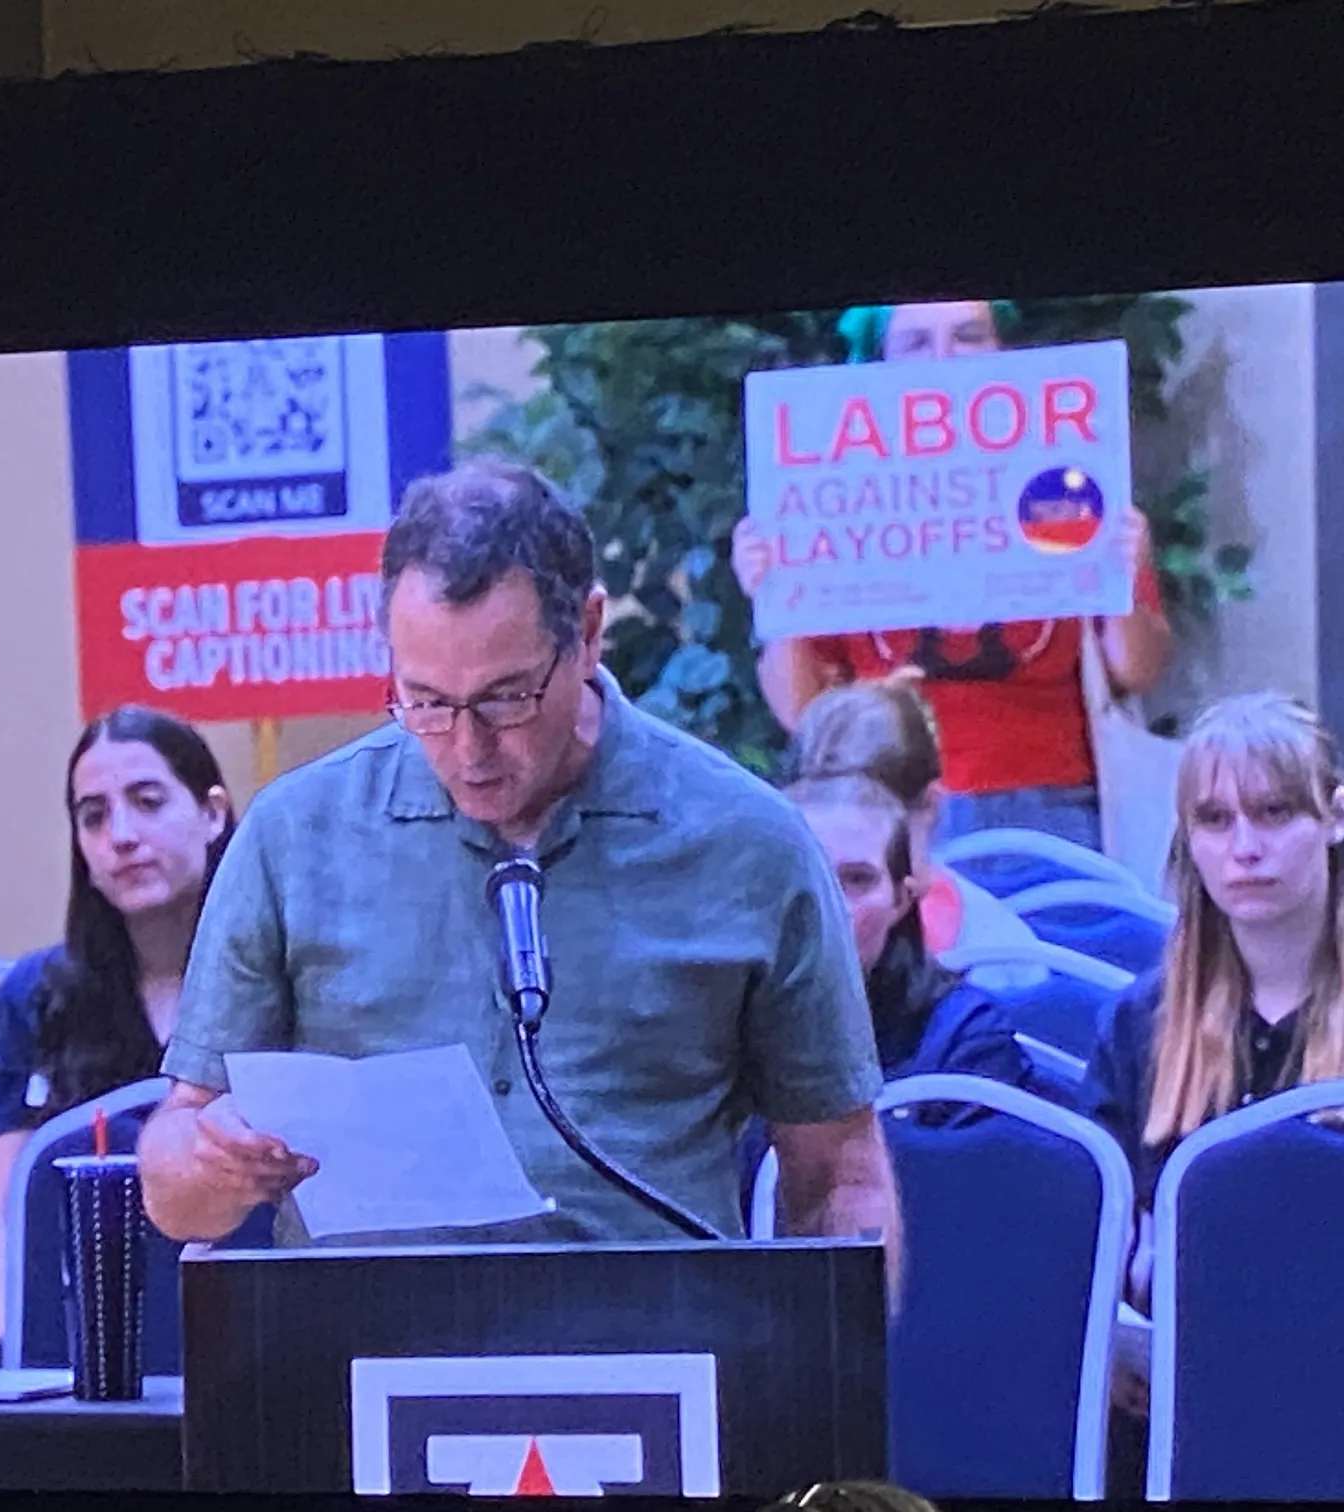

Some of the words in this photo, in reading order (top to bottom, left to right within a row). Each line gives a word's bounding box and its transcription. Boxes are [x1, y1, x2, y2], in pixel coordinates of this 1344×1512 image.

[776, 377, 1099, 466] LABOR
[201, 488, 277, 524] SCAN
[776, 465, 1007, 520] AGAINST
[776, 515, 1010, 567] LAYOFFS
[121, 583, 230, 641] SCAN
[233, 576, 319, 632] FOR
[324, 573, 384, 628] LIV
[144, 624, 391, 690] CAPTIONING
